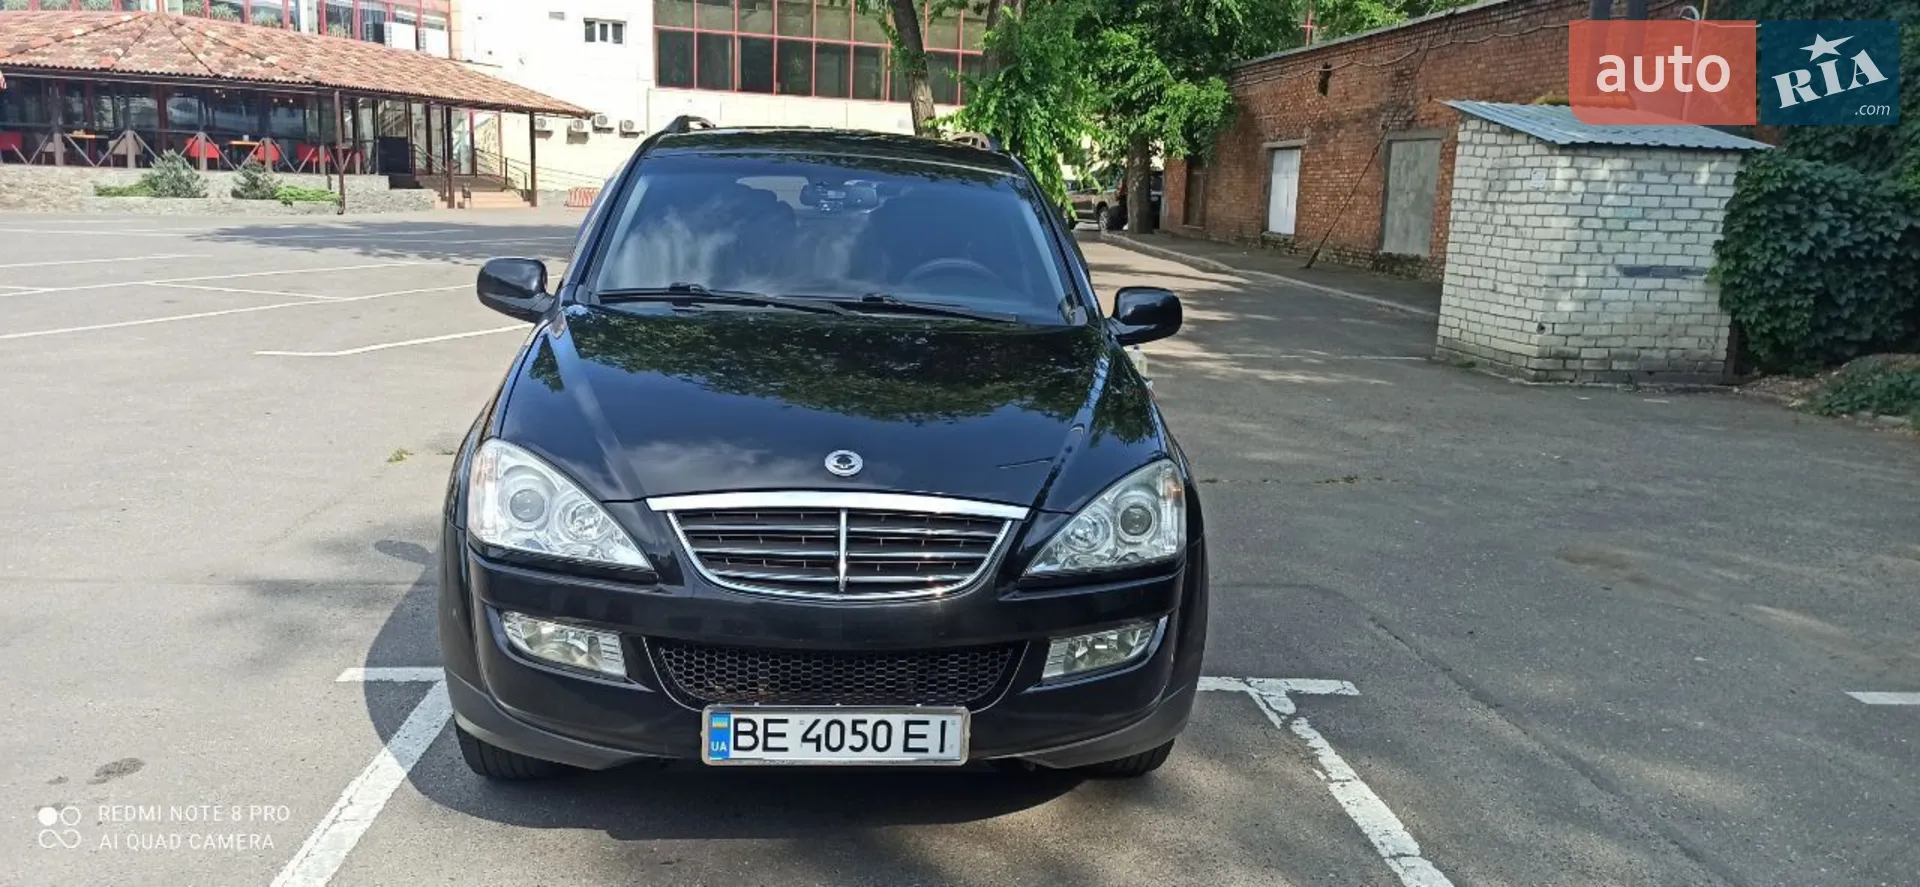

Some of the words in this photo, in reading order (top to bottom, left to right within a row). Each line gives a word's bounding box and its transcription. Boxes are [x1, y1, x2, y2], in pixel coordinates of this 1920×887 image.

[710, 740, 727, 752] UA
[732, 717, 790, 753] BE
[800, 718, 893, 753] 4050
[902, 719, 948, 754] EI
